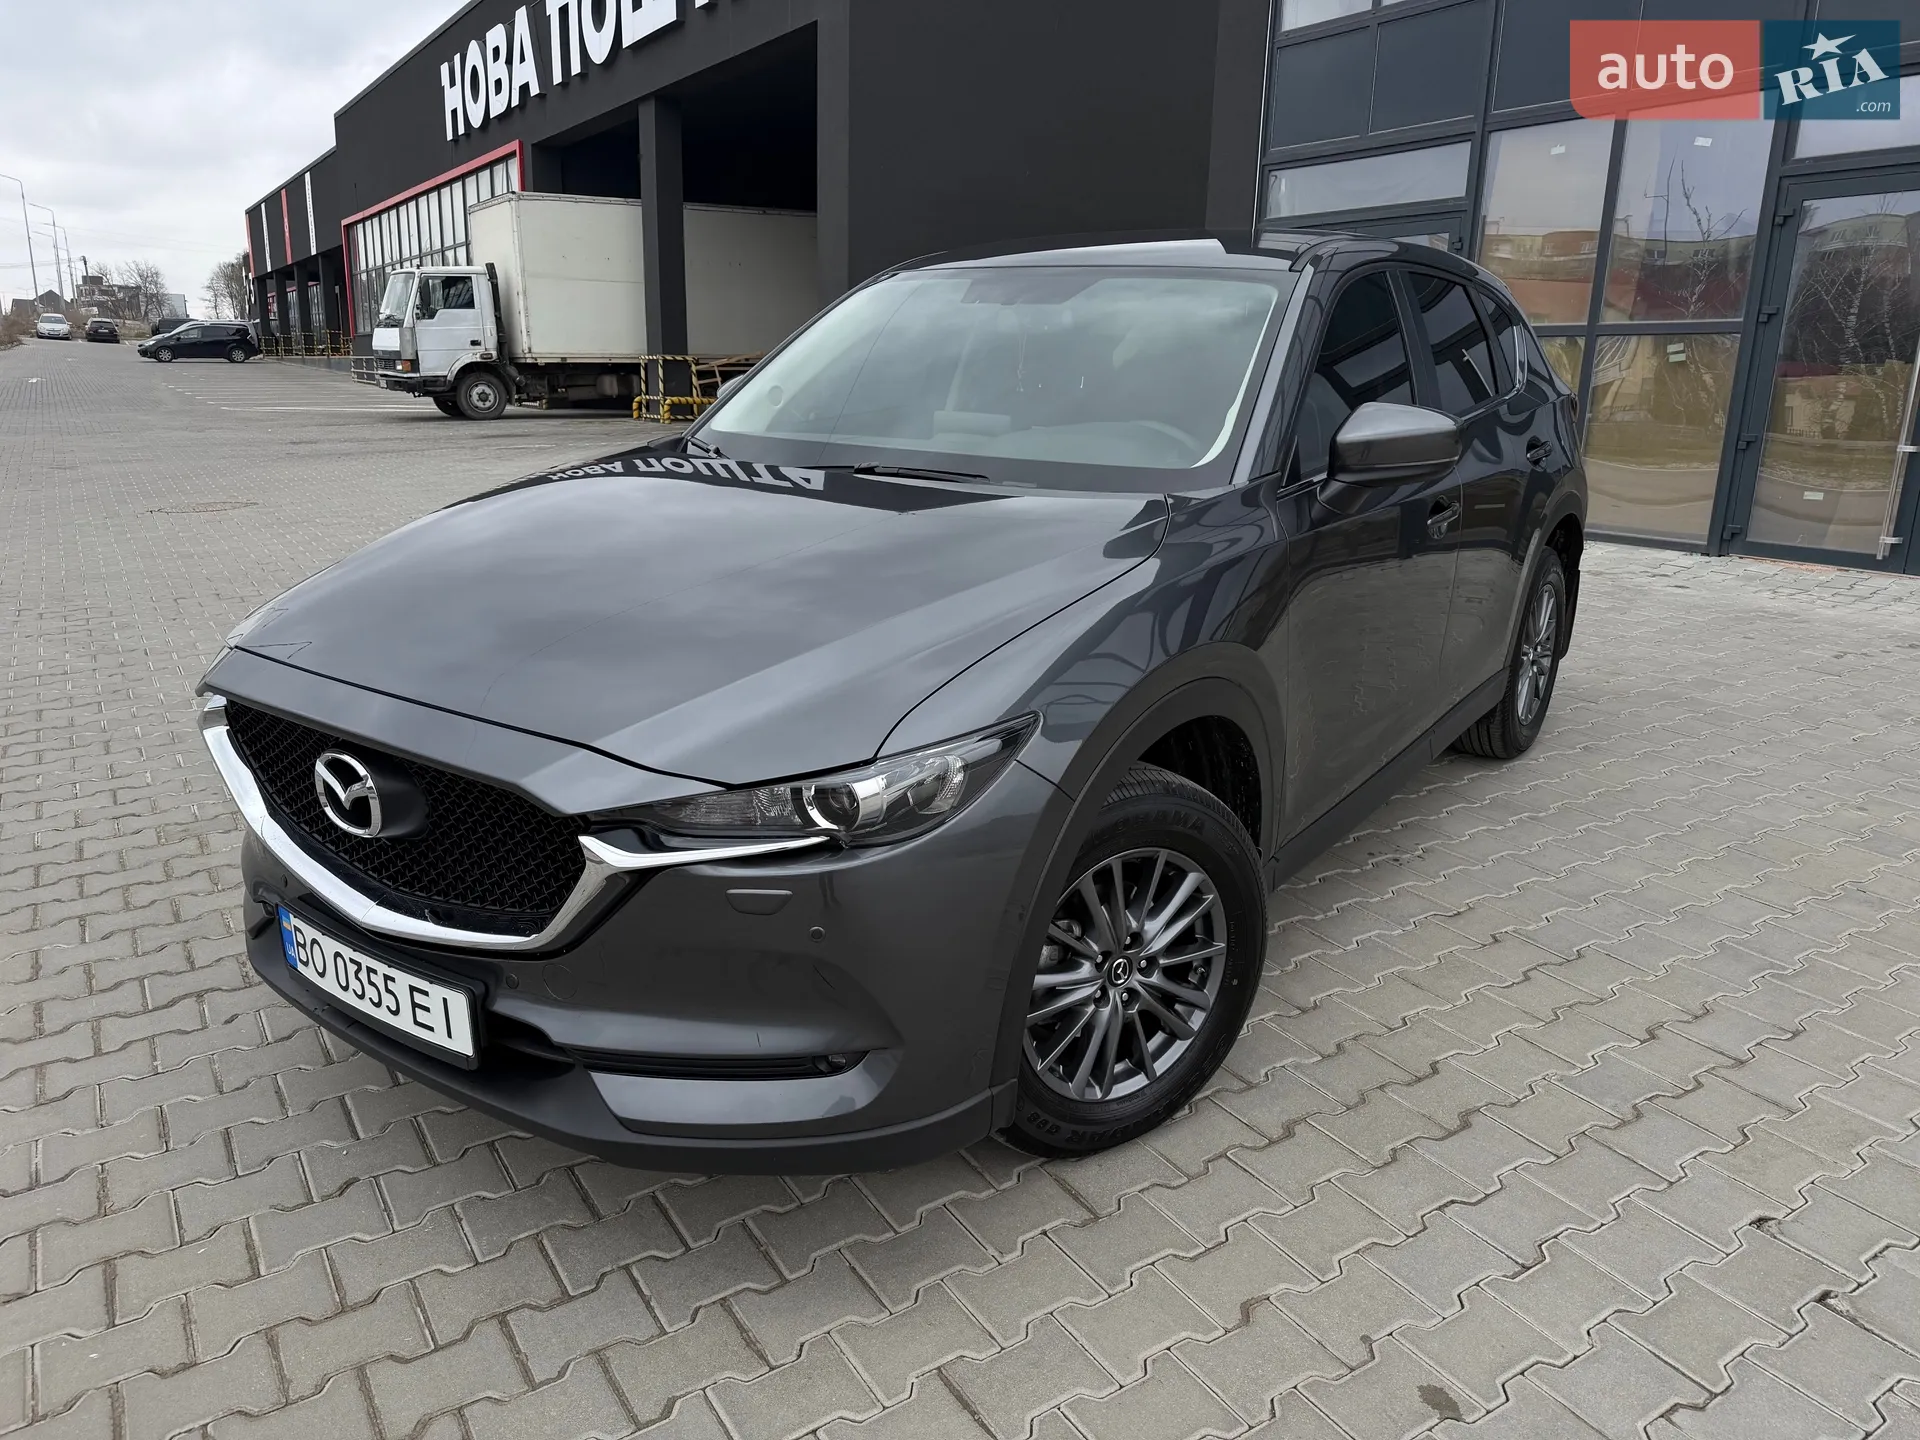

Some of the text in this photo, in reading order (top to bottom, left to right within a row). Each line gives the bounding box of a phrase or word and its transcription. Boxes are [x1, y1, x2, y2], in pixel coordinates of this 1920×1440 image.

[440, 0, 709, 141] НОВА ПО
[293, 923, 453, 1040] BO 0355 EI
